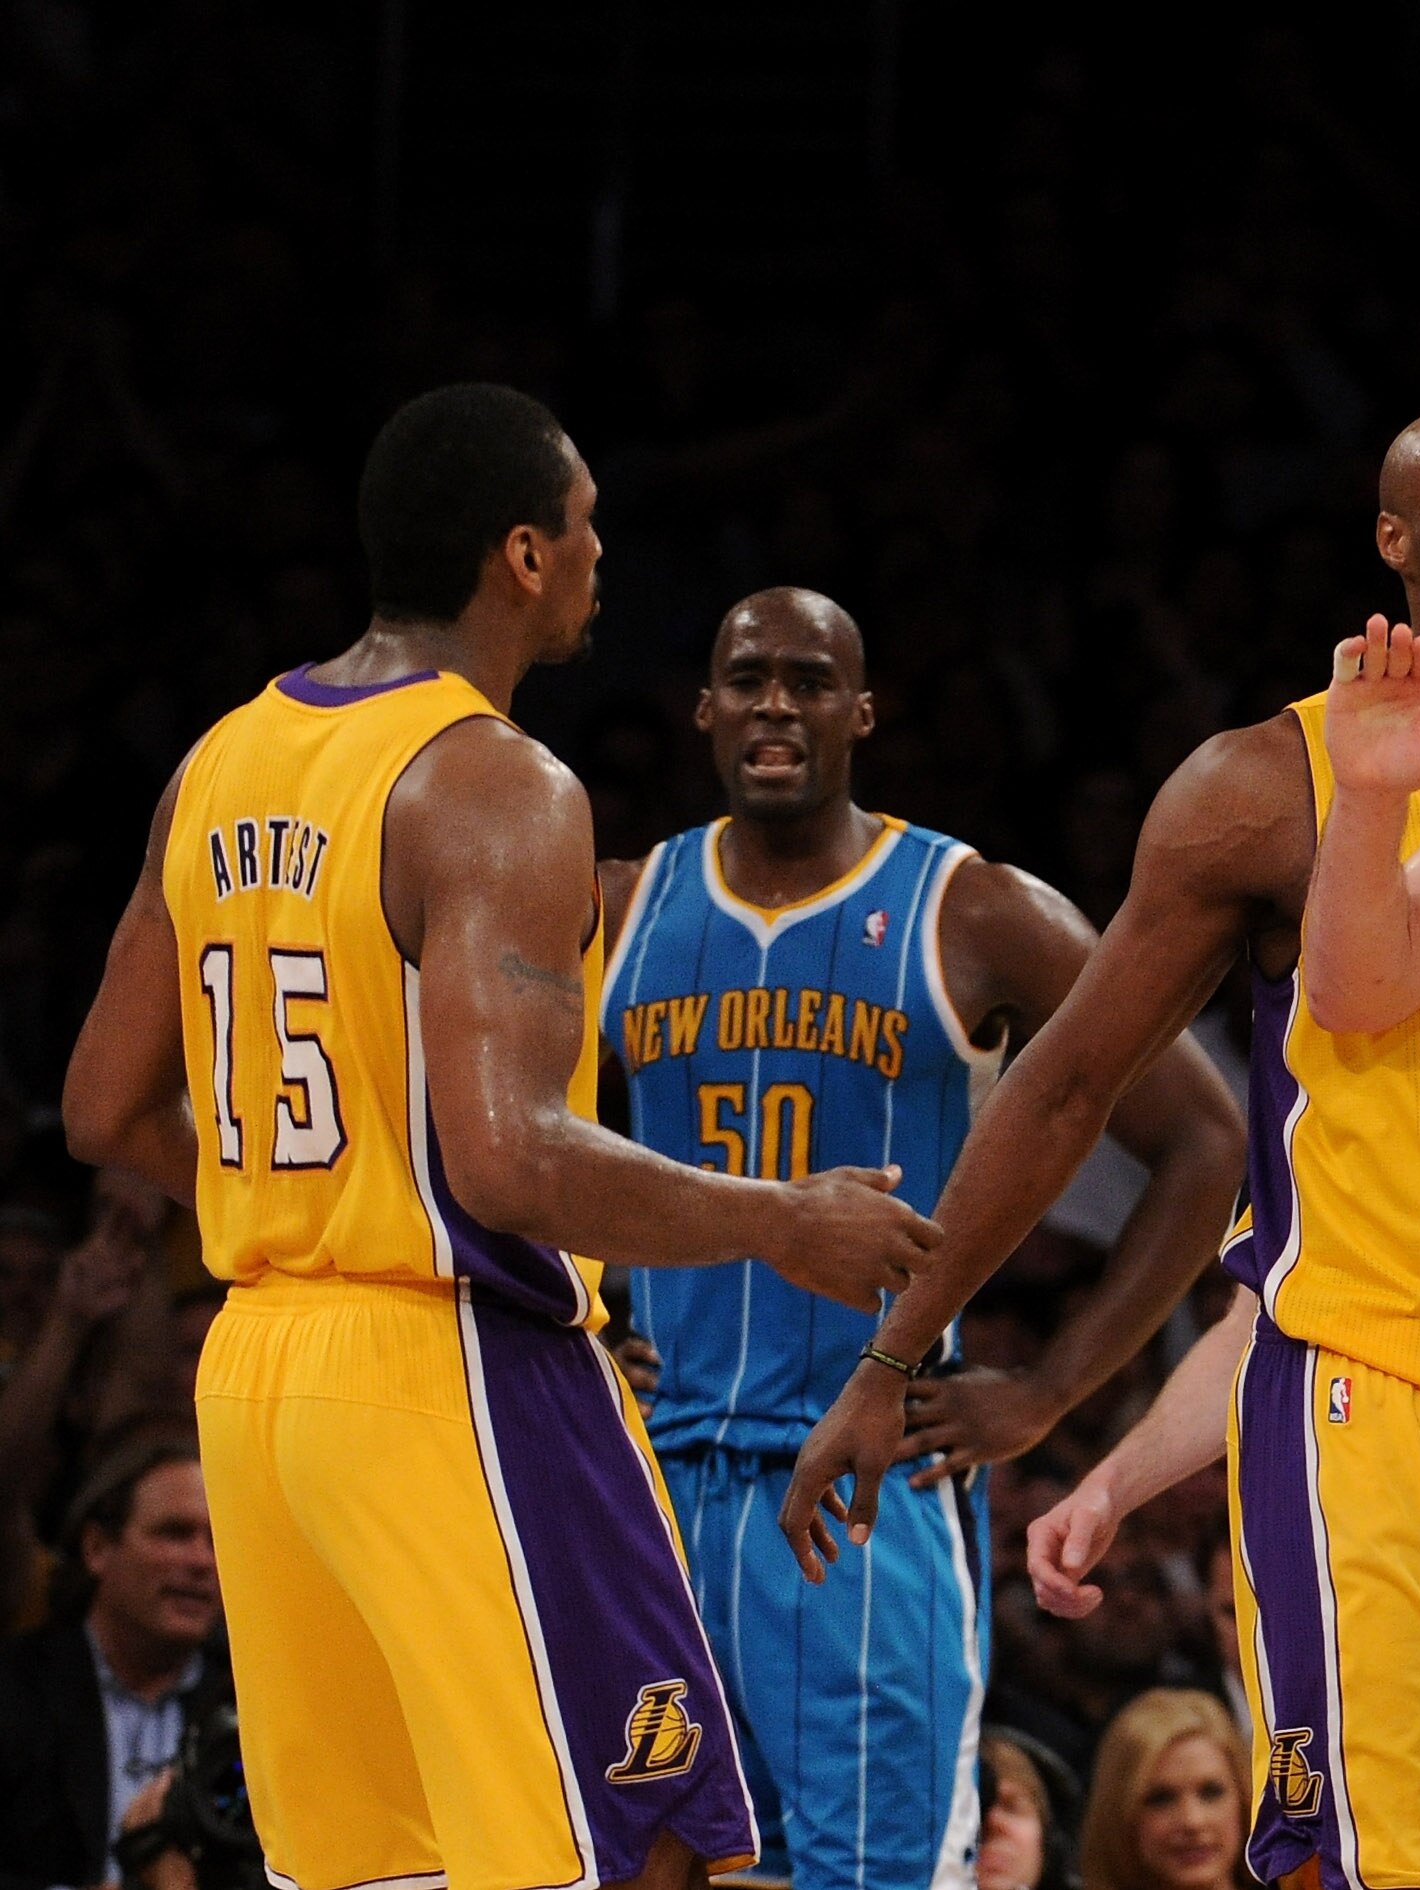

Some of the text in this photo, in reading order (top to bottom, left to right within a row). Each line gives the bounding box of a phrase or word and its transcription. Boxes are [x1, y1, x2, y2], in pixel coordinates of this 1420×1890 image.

[208, 816, 328, 902] ARTST
[201, 943, 348, 1171] 15
[623, 987, 908, 1080] NEW ORLEANS
[697, 1082, 816, 1183] 50
